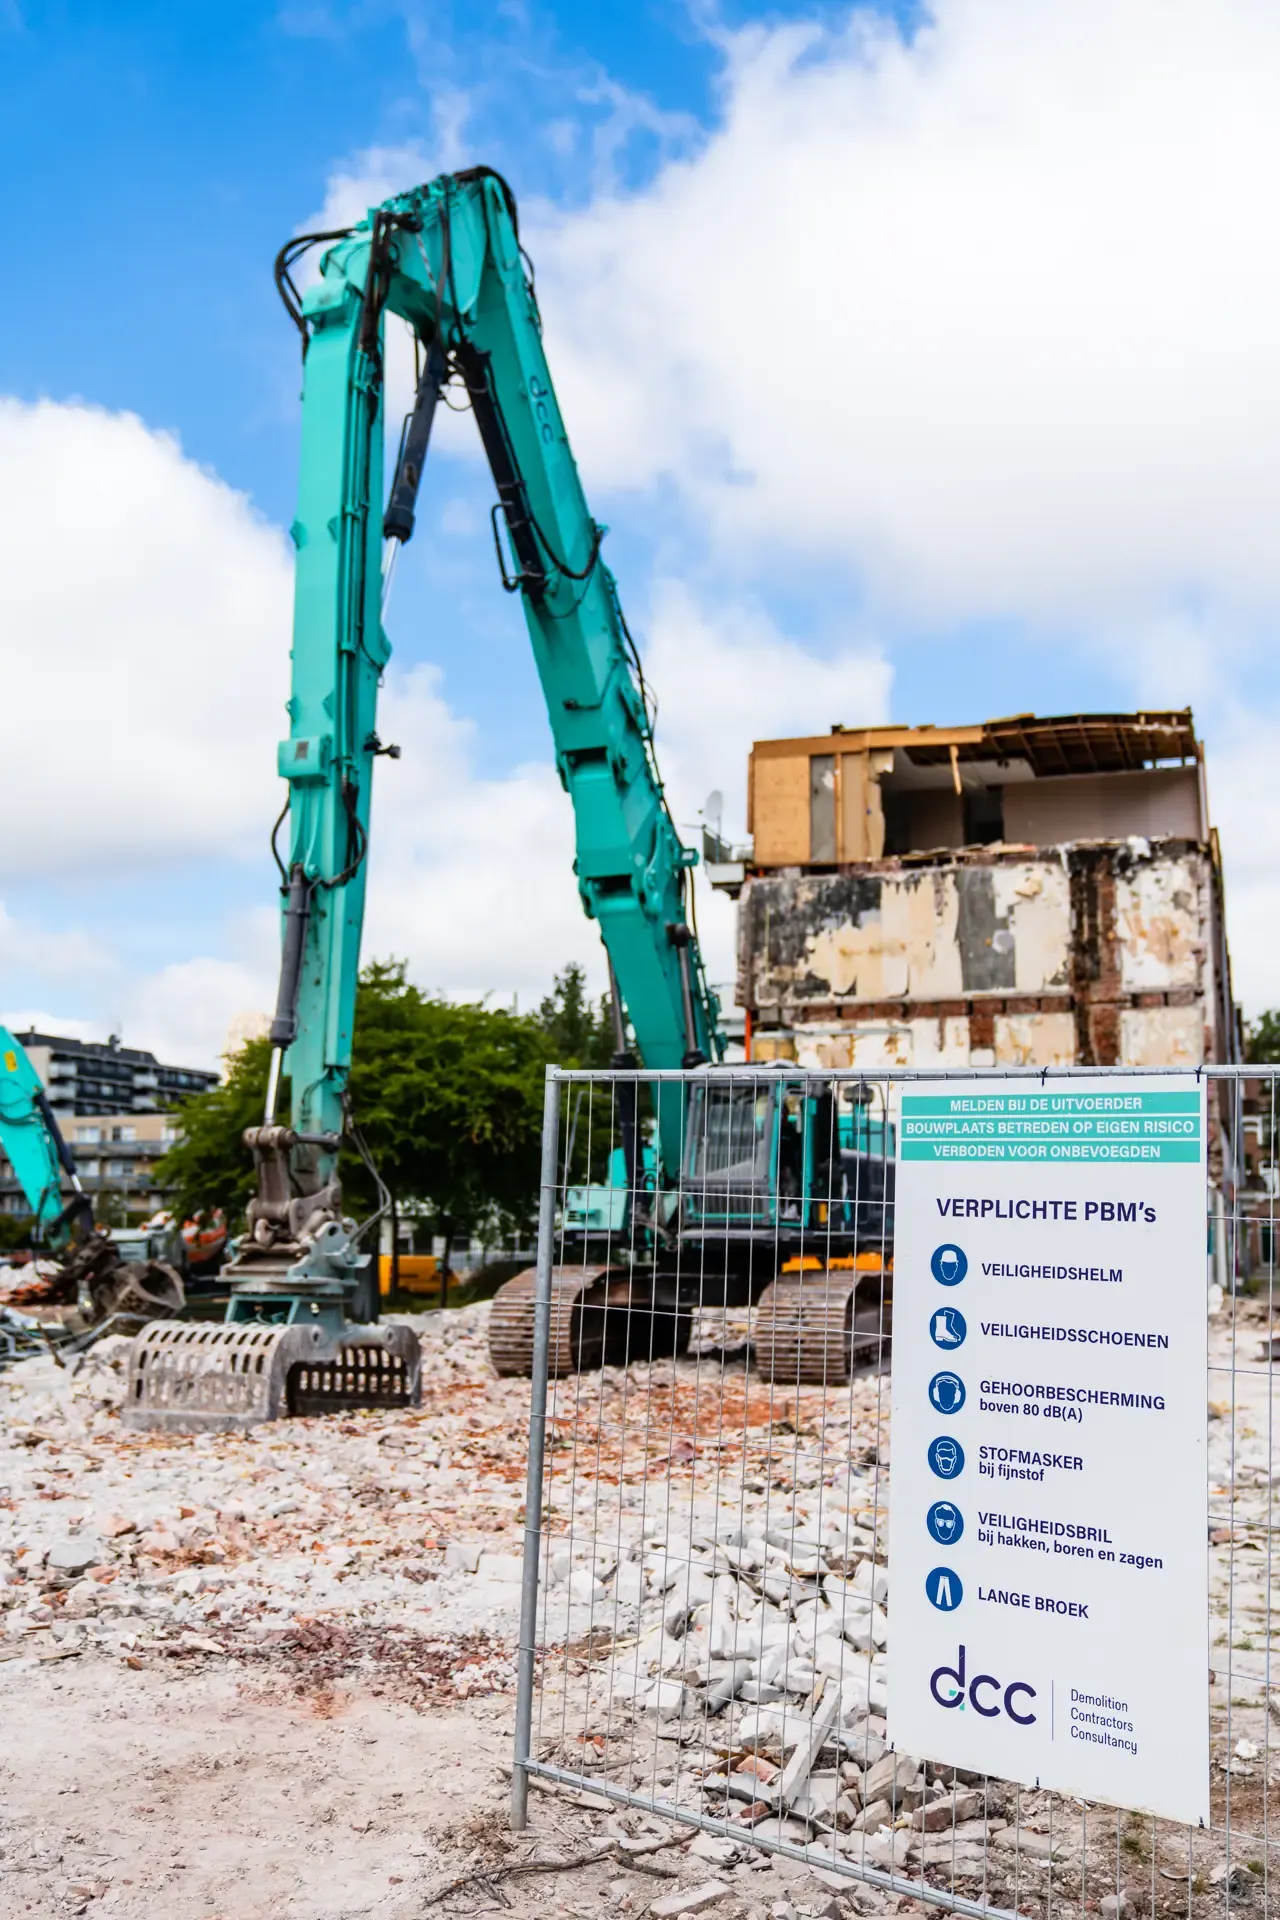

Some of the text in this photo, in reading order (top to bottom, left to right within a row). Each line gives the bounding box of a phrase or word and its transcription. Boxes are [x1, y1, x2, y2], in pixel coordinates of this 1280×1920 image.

[950, 1098, 1143, 1112] MELDEN BIJ DE UITVOERDER
[906, 1121, 1195, 1134] BOUWPLAATS BETREDEN OP EIGEN RISICO
[934, 1145, 1161, 1158] VERBODEN VOOR ONBEVOEGDEN
[936, 1198, 1157, 1223] VERPLICHTE PBM's
[982, 1263, 1123, 1283] VEILIGHEIDSHELM
[980, 1323, 1169, 1349] VEILIGHEIDSSCHOENEN
[980, 1381, 1165, 1410] GEHOORBESCHERMING
[980, 1399, 1083, 1423] boven 80 dB(A)
[979, 1446, 1083, 1471] STOFMASKER
[979, 1462, 1044, 1482] bij fijnstof
[978, 1511, 1113, 1544] VEILIGHEIDSBRIL
[978, 1529, 1163, 1570] bij hakken, boren en zagen
[979, 1587, 1089, 1619] LANGE BROEK
[930, 1644, 1037, 1725] dcc
[1071, 1689, 1128, 1712] Demolition
[1070, 1707, 1133, 1732] Contractors
[1070, 1725, 1138, 1755] Consultancy
